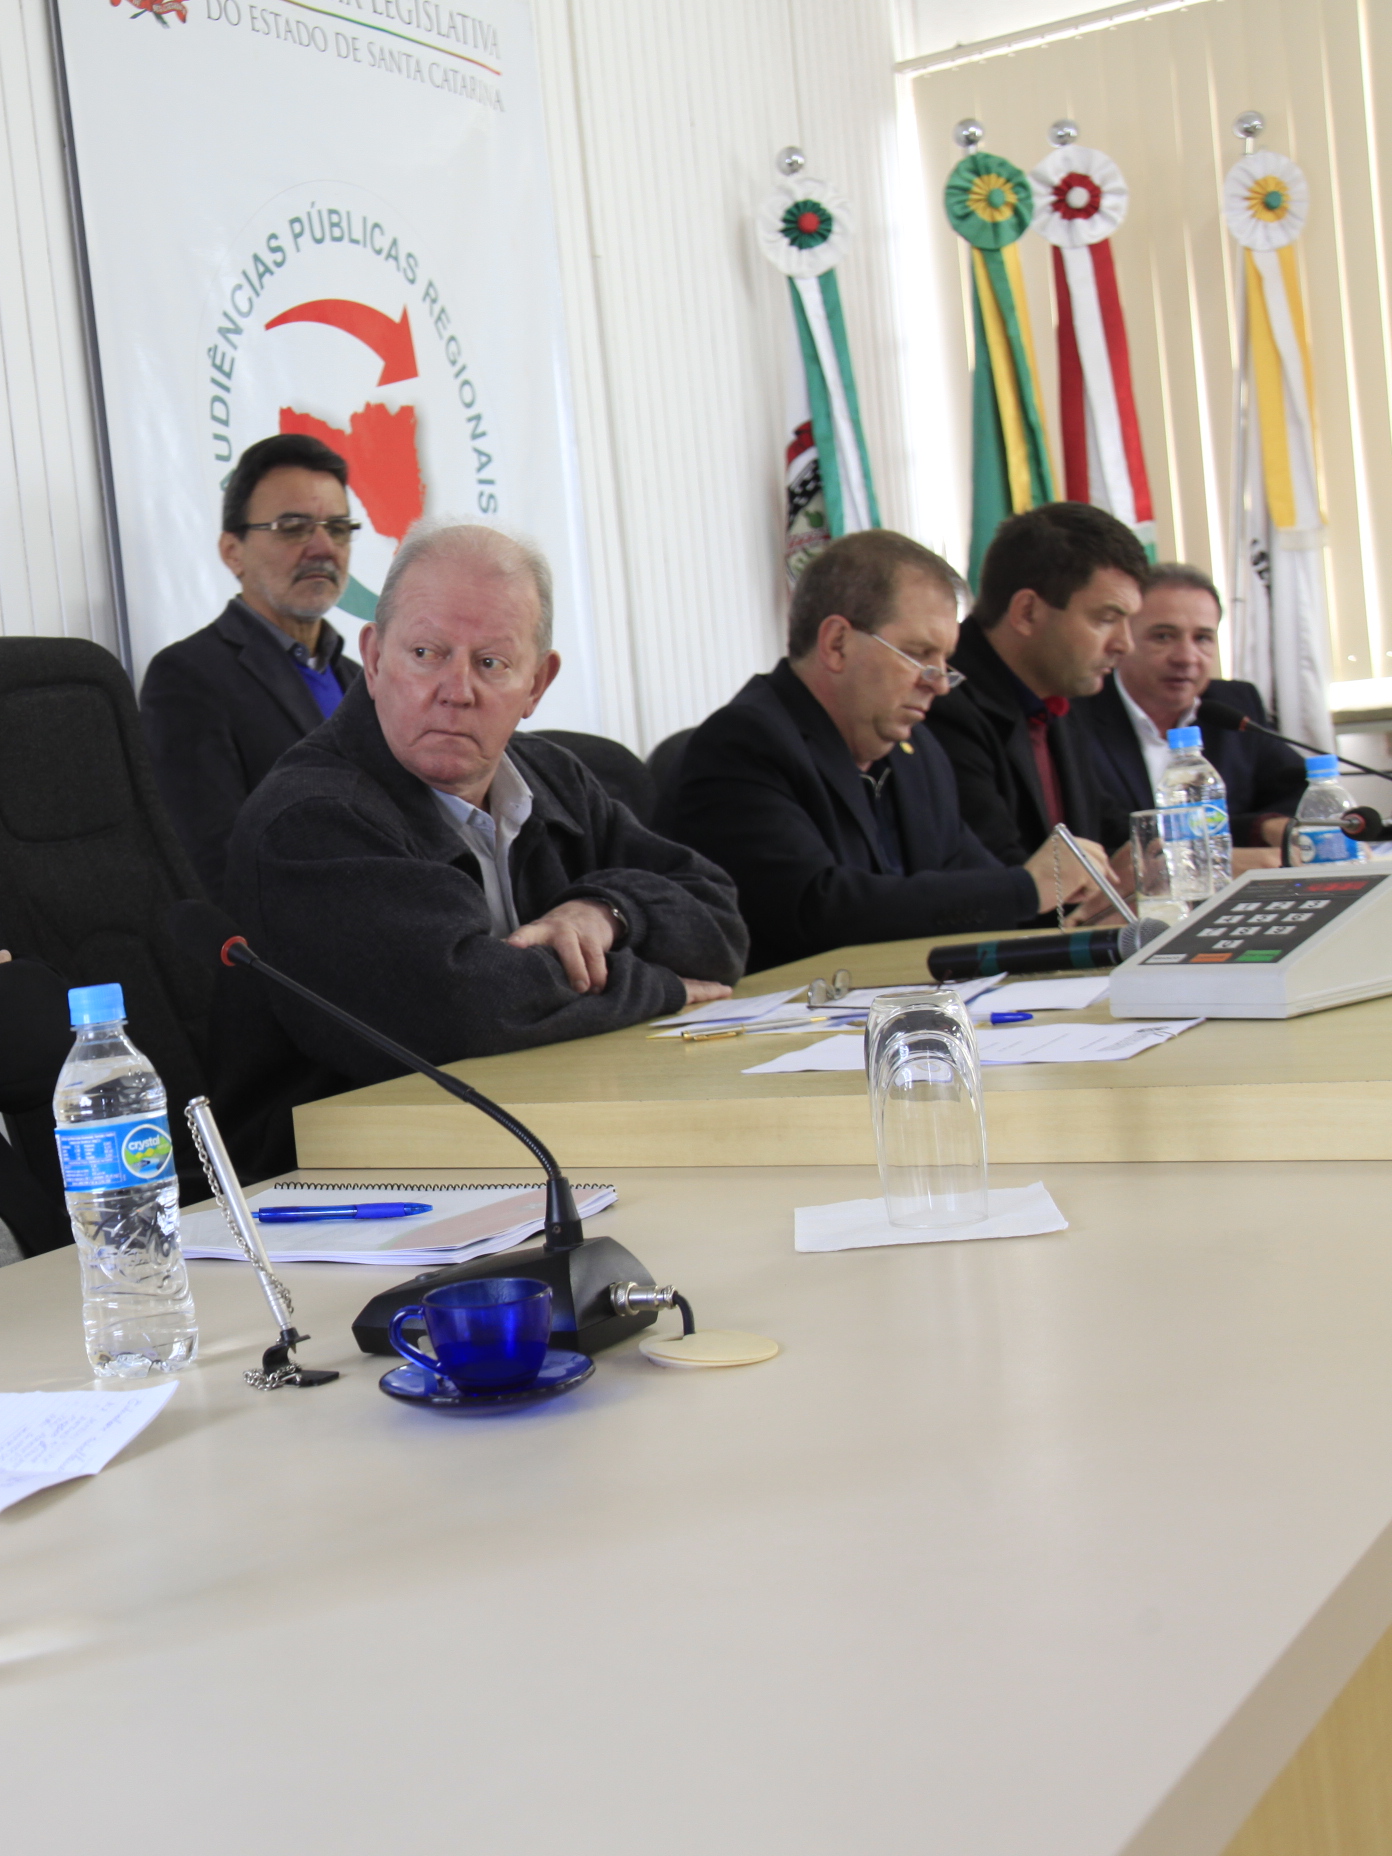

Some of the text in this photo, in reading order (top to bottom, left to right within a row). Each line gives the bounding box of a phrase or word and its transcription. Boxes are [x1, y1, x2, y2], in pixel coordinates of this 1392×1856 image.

[207, 0, 506, 112] DO ESTADO DE SANTA CATARINA
[288, 201, 419, 285] PÚBLICAS
[422, 279, 498, 515] REGIONAIS
[128, 1134, 161, 1151] crystal
